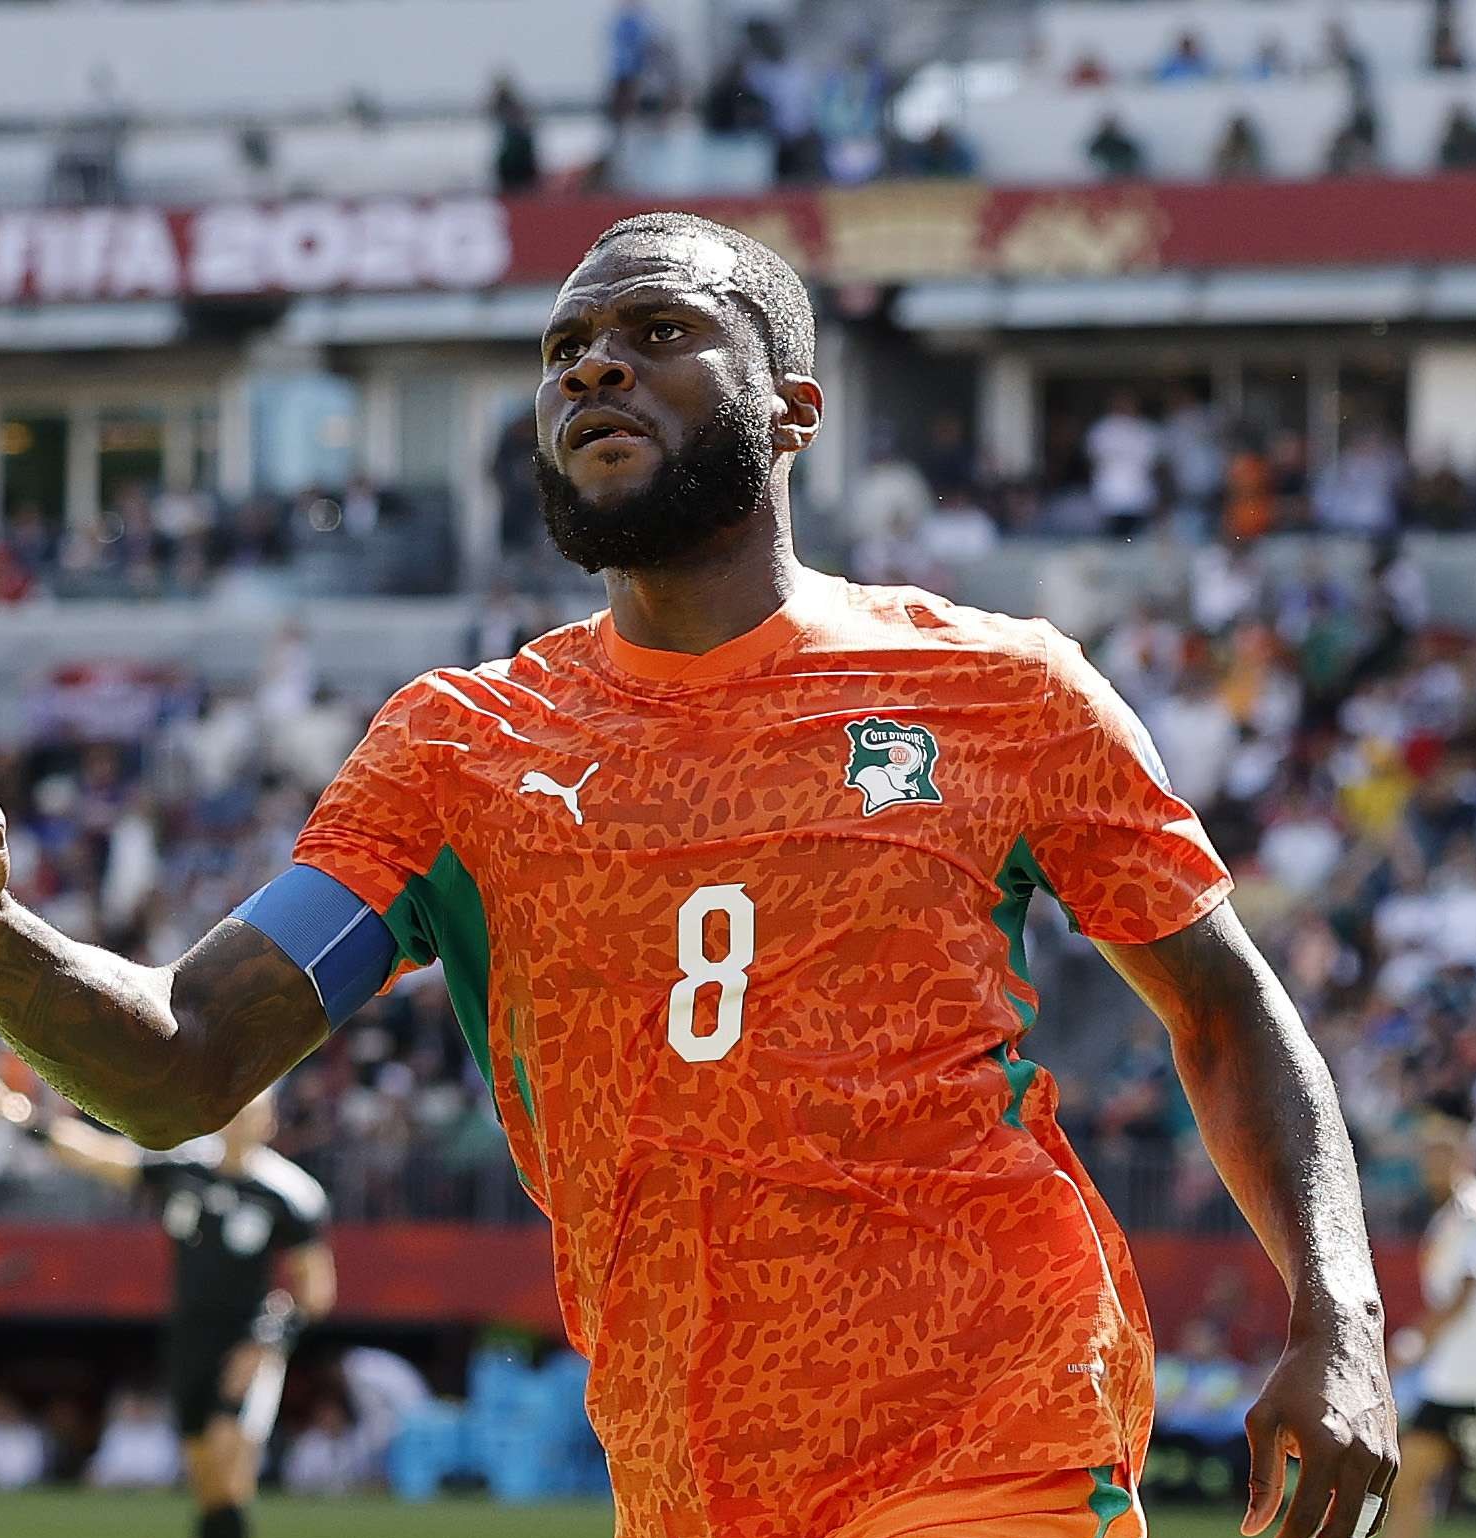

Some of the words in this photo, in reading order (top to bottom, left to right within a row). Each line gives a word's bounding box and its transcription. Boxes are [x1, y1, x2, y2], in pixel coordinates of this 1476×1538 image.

[185, 198, 510, 294] 2026
[889, 731, 926, 748] D'IVOIRE
[667, 882, 755, 1063] 8
